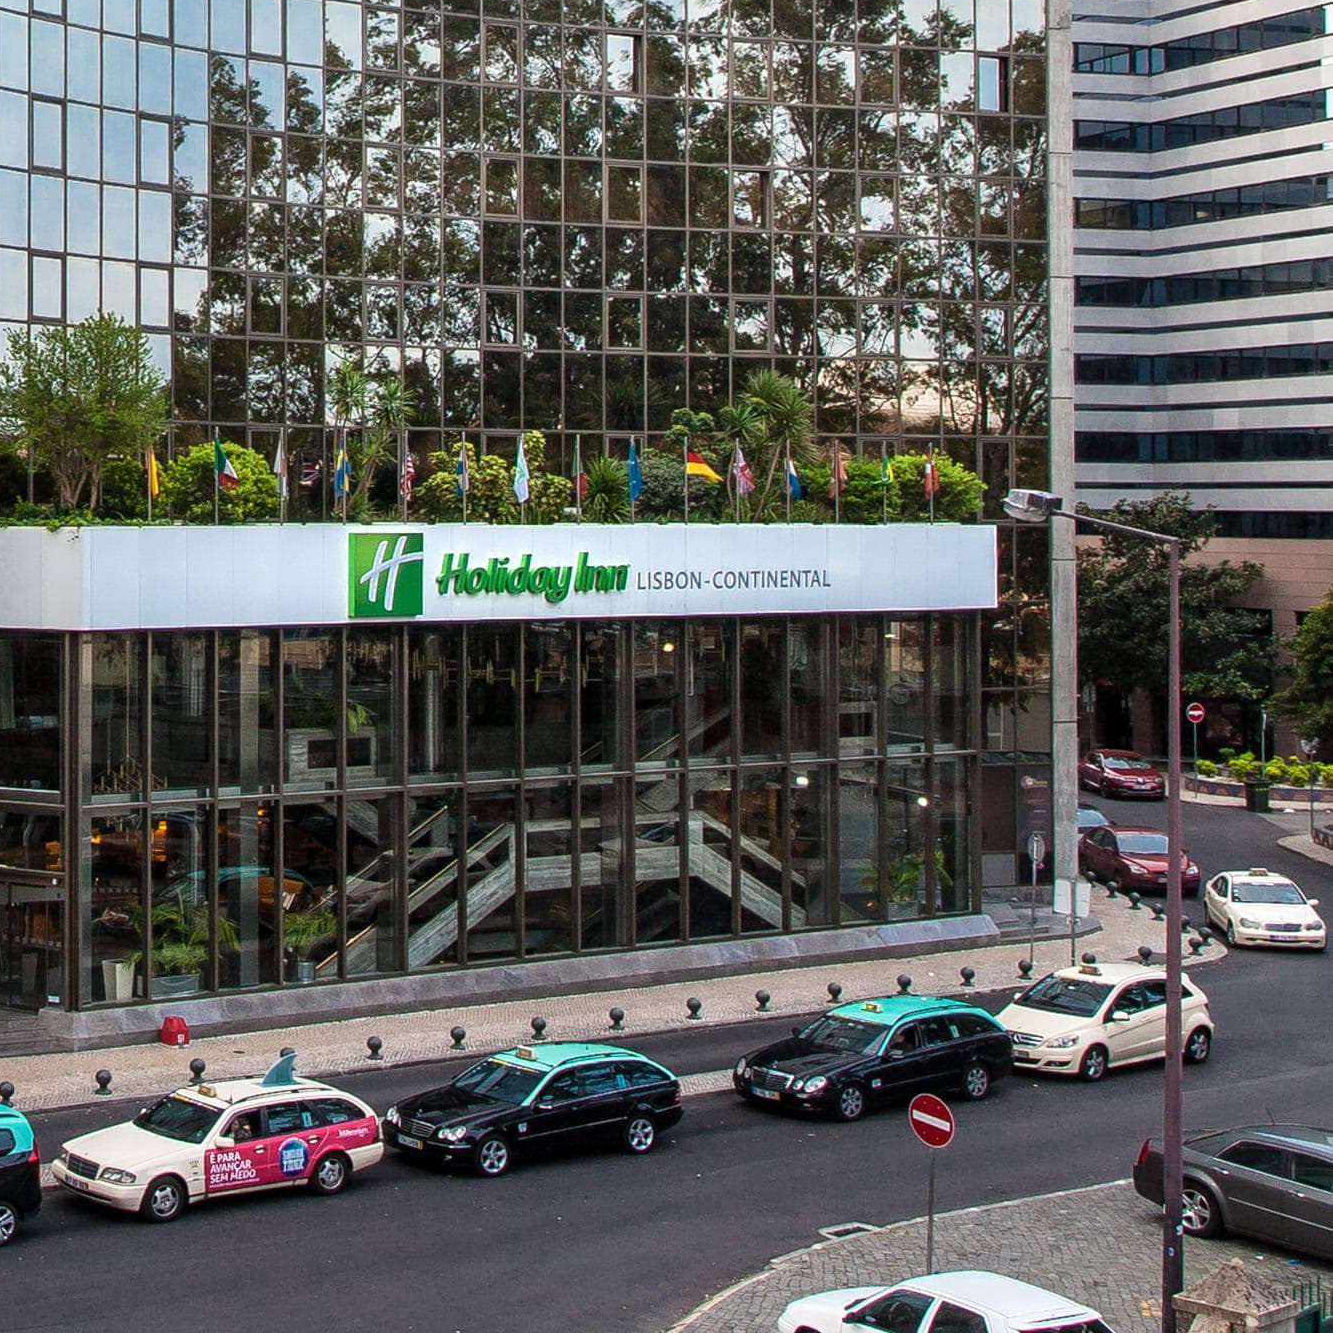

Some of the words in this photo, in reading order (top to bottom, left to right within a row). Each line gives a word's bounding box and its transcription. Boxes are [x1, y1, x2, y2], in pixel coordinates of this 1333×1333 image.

[436, 552, 572, 603] Holiday
[574, 551, 630, 593] Inn
[636, 569, 831, 590] LISBON-CONTINENTAL
[209, 1151, 217, 1164] É
[217, 1151, 241, 1164] PARA
[209, 1159, 252, 1174] AVANÇAR
[209, 1173, 229, 1184] SEM
[229, 1169, 256, 1181] MEDO
